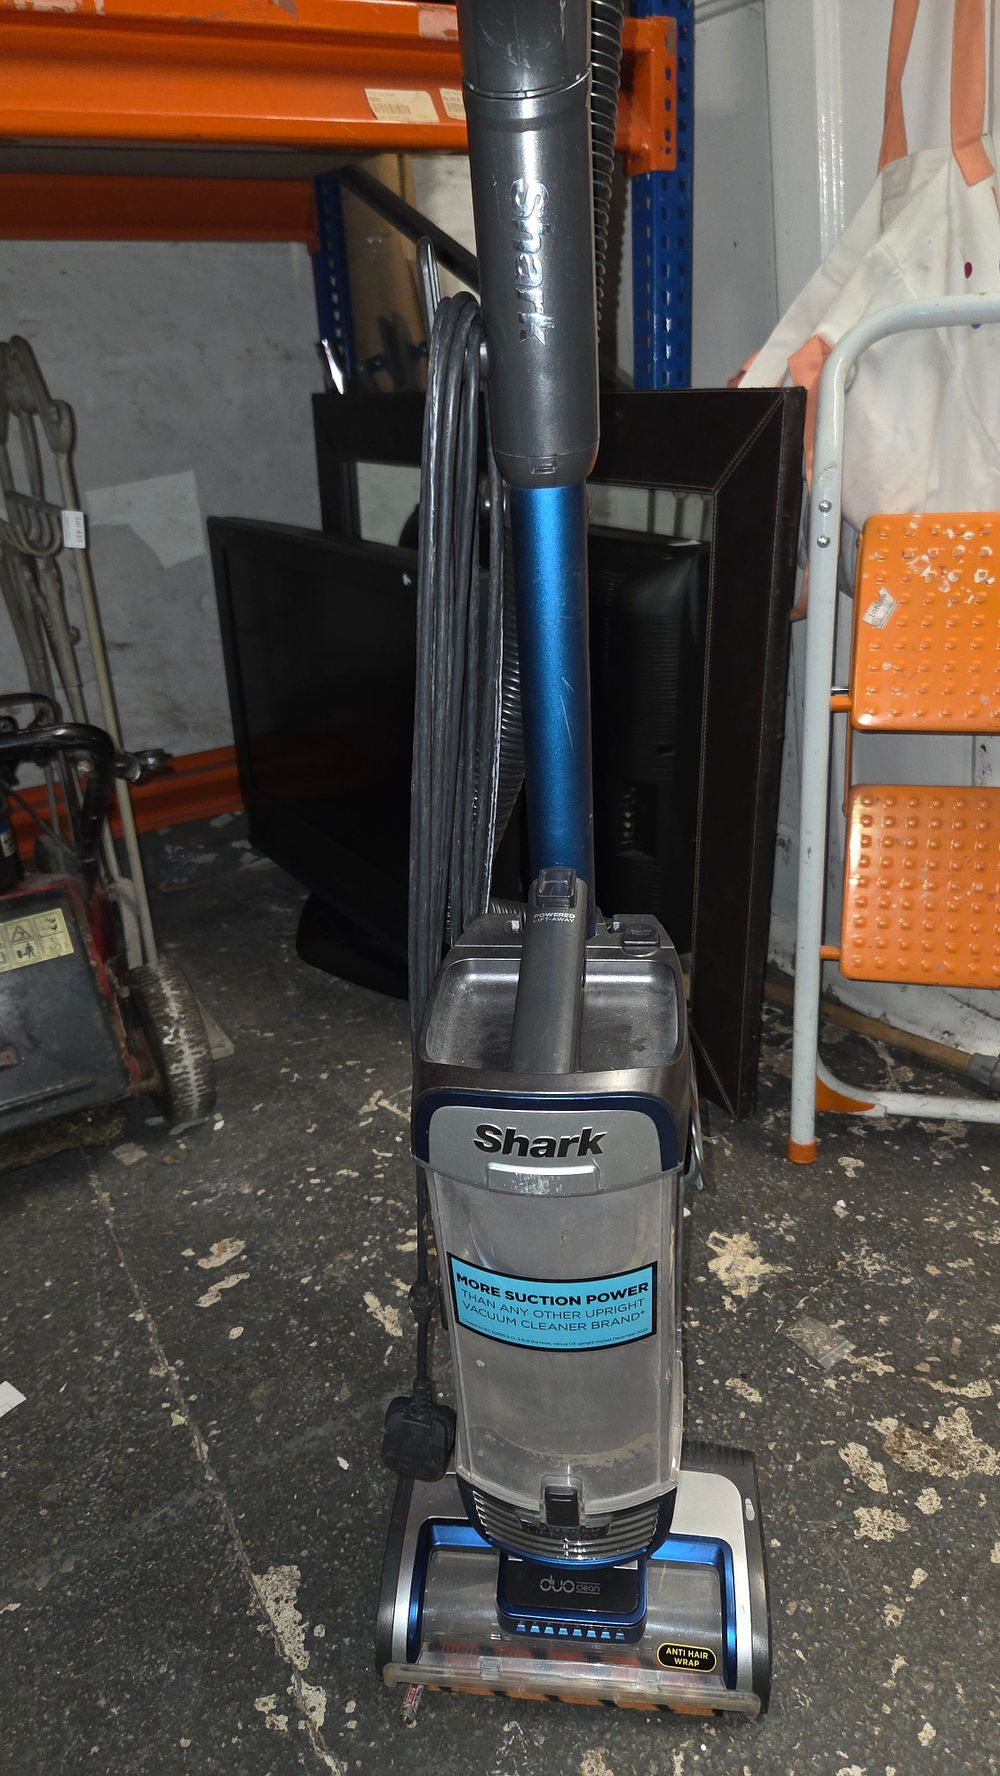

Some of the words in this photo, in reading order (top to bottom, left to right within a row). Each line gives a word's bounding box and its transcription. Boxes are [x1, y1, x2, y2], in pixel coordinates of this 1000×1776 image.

[510, 179, 554, 345] Shark
[473, 1123, 608, 1158] Shark
[456, 1272, 501, 1297] MORE
[505, 1290, 581, 1306] SUCTION
[586, 1282, 649, 1304] POWER
[461, 1288, 496, 1309] THAN
[500, 1304, 528, 1316] ANY
[533, 1310, 581, 1320] OTHER
[585, 1298, 645, 1318] UPRIGHT
[462, 1301, 517, 1326] VACUUM
[521, 1320, 587, 1332] CLEANER
[540, 1574, 575, 1593] duo
[575, 1582, 600, 1593] clean
[665, 1647, 686, 1657] ANTI
[687, 1650, 709, 1660] HAIR
[674, 1657, 700, 1667] WRAP
